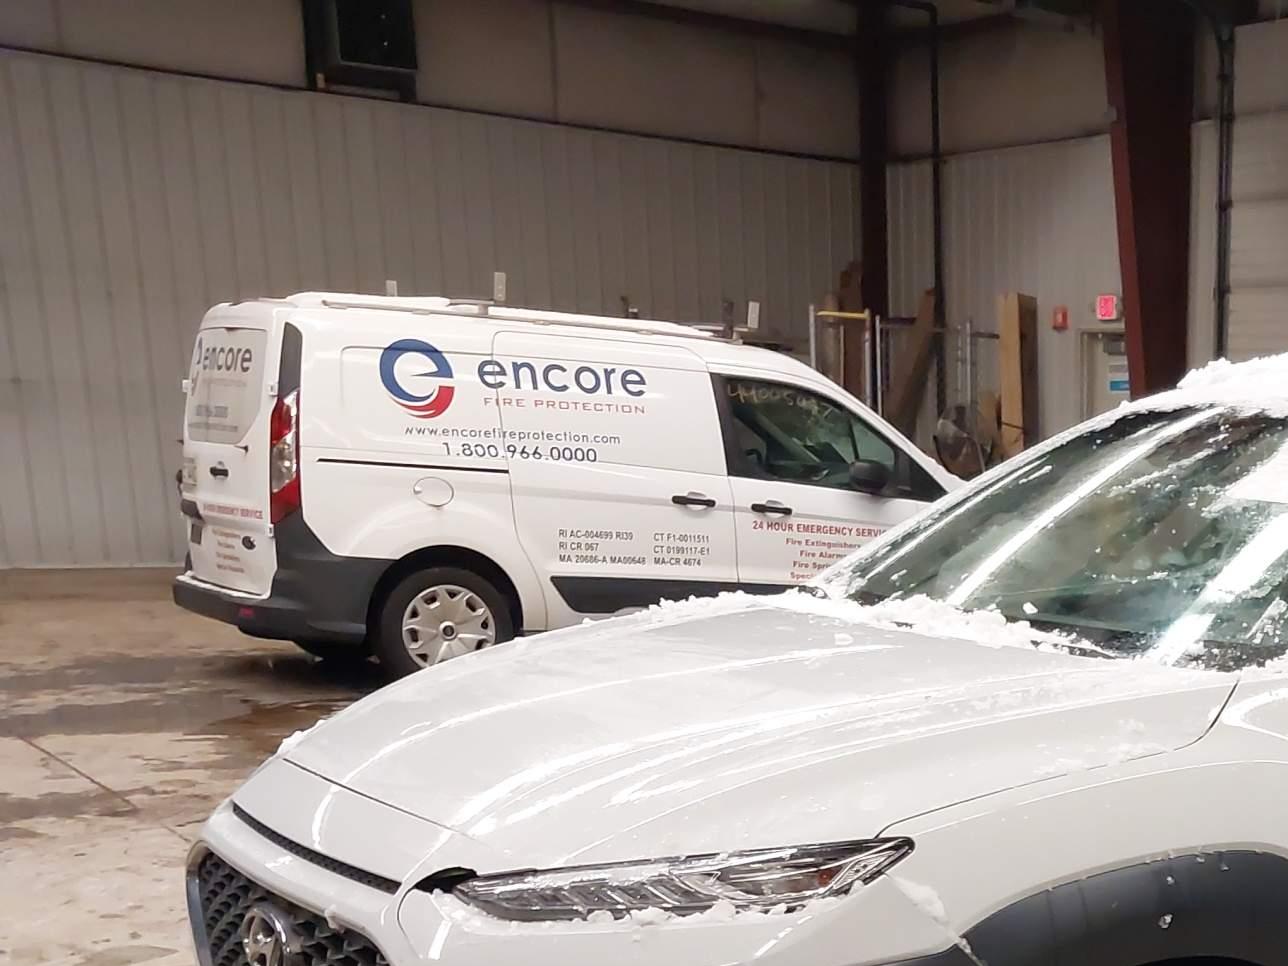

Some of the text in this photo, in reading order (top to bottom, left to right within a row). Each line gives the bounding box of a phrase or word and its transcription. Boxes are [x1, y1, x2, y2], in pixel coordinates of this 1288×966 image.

[203, 347, 252, 372] encore
[477, 359, 647, 397] encore
[483, 397, 646, 414] FIRE PROTECTION
[404, 426, 621, 445] www.encorefireprotection.com
[442, 442, 598, 463] 1.800.966.0000
[559, 529, 568, 538] RI
[653, 533, 664, 541] CT
[753, 521, 764, 530] 24
[767, 521, 794, 532] HOUR
[797, 524, 853, 537] EMERGENCY
[559, 541, 568, 550] RI
[570, 542, 582, 551] CR
[653, 545, 664, 554] CT
[800, 550, 816, 558] Fire
